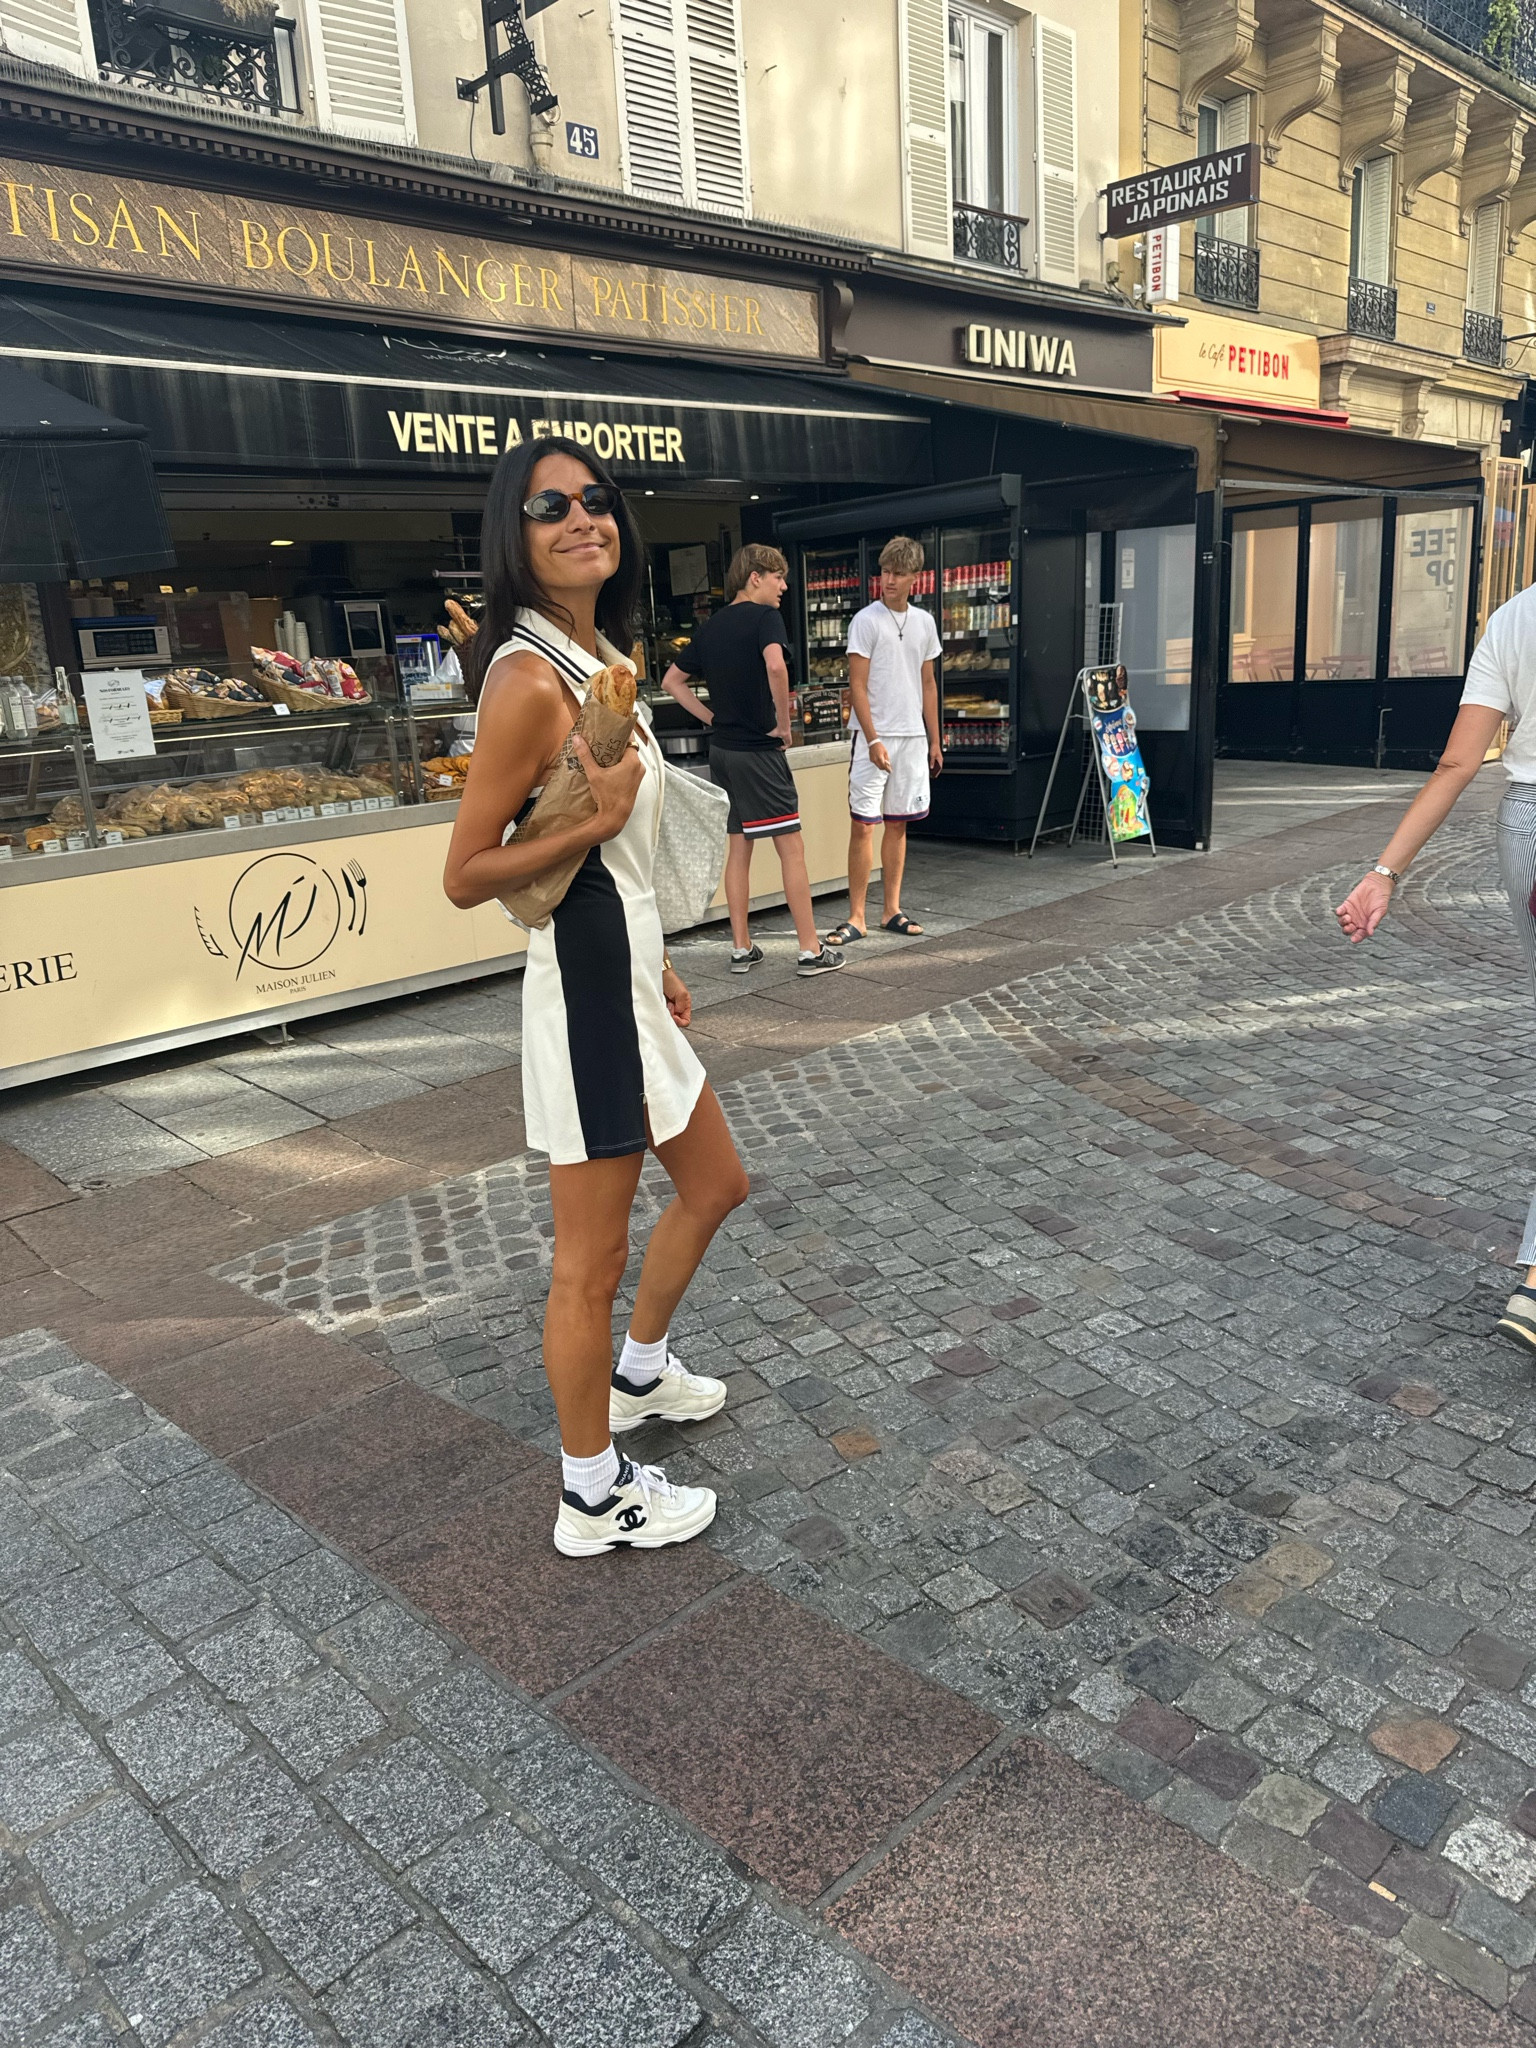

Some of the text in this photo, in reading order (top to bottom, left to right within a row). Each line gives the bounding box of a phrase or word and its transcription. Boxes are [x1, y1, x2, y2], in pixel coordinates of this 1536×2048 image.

[569, 126, 596, 156] 45
[1111, 152, 1247, 208] RESTAURANT
[1126, 180, 1230, 225] JAPONAIS
[0, 181, 766, 337] TISAN BOULANGER PATISSIER
[1151, 234, 1162, 292] PETIBON
[966, 323, 1077, 377] ONIWA
[1228, 344, 1289, 380] PETIBON
[386, 410, 499, 456] VENTE
[504, 417, 524, 453] A
[591, 741, 604, 756] ON
[600, 738, 621, 767] QUES
[255, 969, 336, 994] MAISON JULIEN
[289, 986, 307, 994] PARIS
